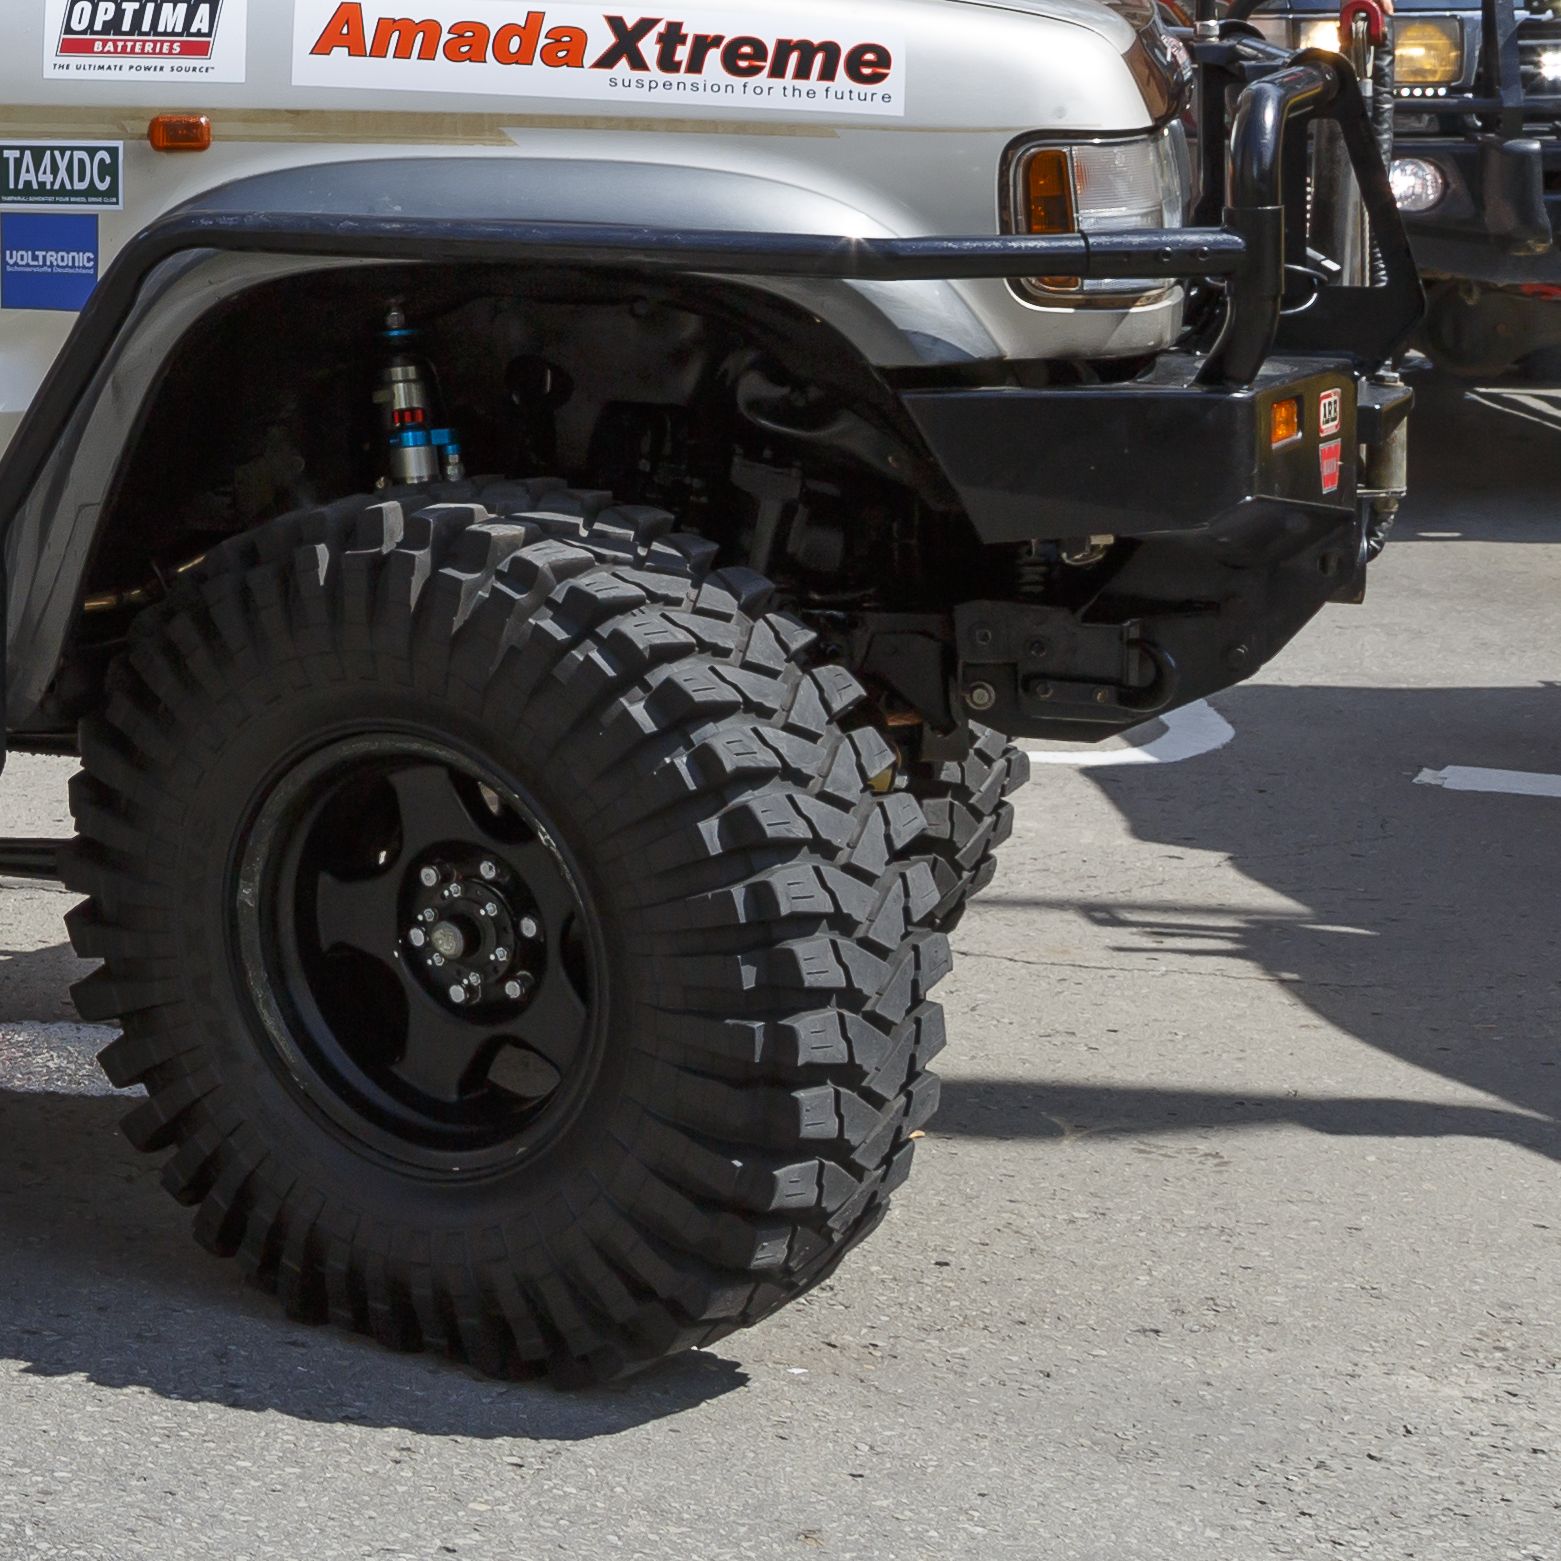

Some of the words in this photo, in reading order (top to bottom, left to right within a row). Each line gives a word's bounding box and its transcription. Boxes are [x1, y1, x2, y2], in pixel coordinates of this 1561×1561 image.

[70, 0, 210, 34] OPTIMA
[93, 40, 181, 54] BATTERIES
[52, 63, 70, 71] THE
[75, 64, 124, 72] ULTIMATE
[128, 64, 165, 73] POWER
[169, 65, 210, 74] SOURCE
[608, 76, 735, 95] suspension
[742, 82, 774, 97] for
[782, 84, 817, 99] the
[824, 86, 892, 104] future
[3, 149, 112, 191] TA4XDC
[5, 250, 94, 267] VOLTRONIC
